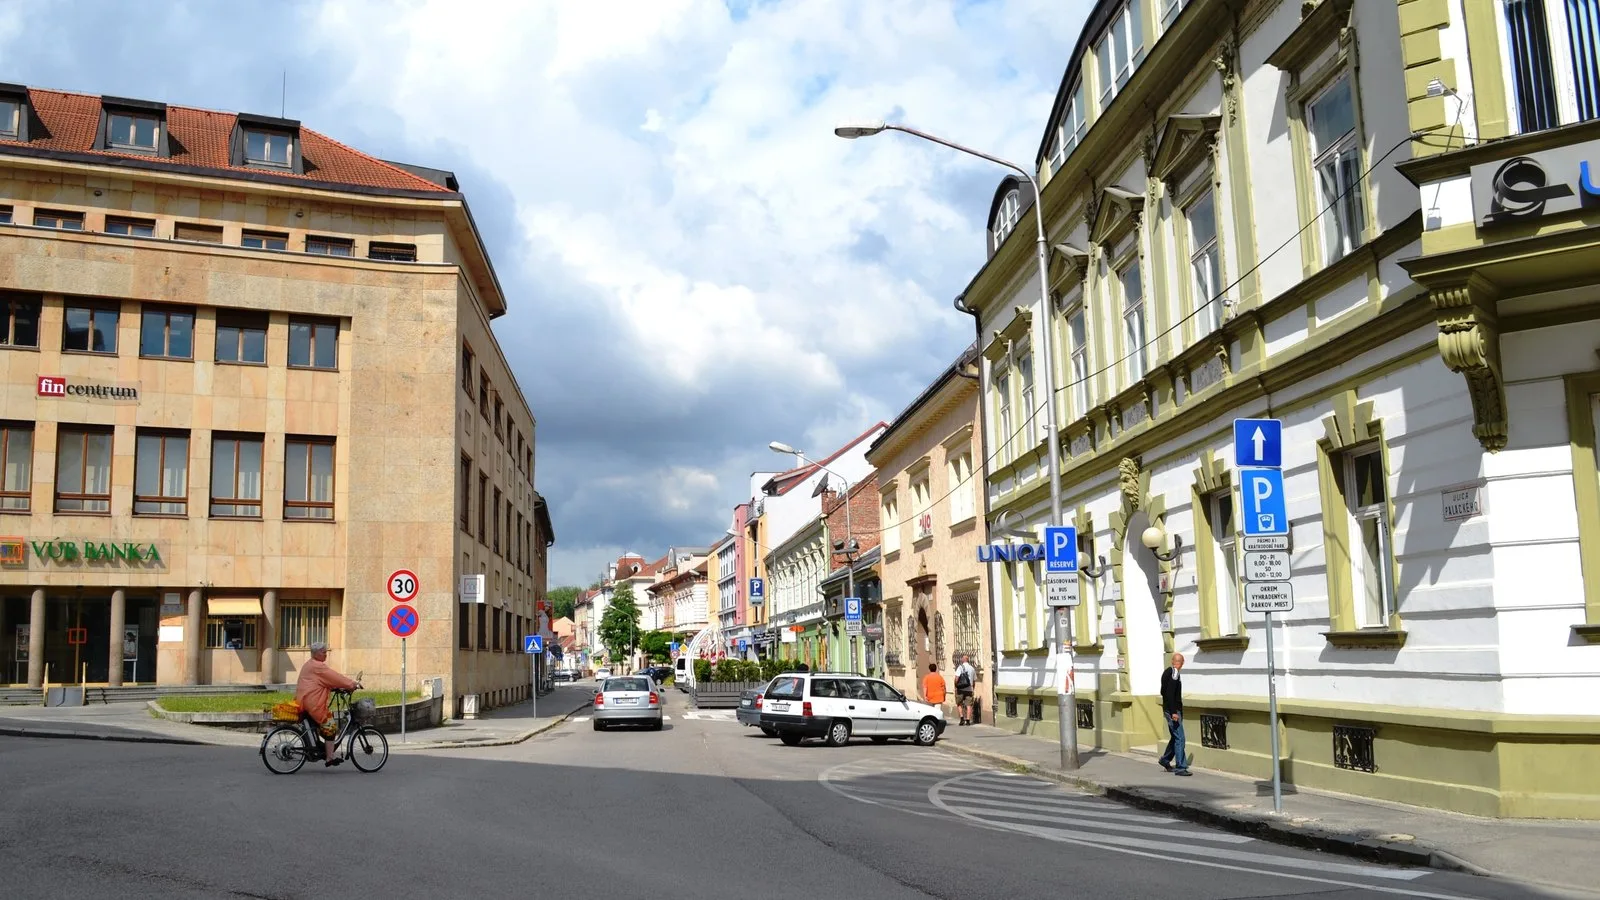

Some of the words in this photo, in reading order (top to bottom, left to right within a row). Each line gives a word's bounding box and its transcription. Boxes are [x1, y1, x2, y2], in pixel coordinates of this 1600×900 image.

[1252, 477, 1273, 513] P
[31, 537, 79, 561] VÚB
[83, 541, 160, 561] BANKA
[977, 543, 1046, 562] UNIQA
[1053, 532, 1068, 557] P
[394, 578, 414, 594] 30
